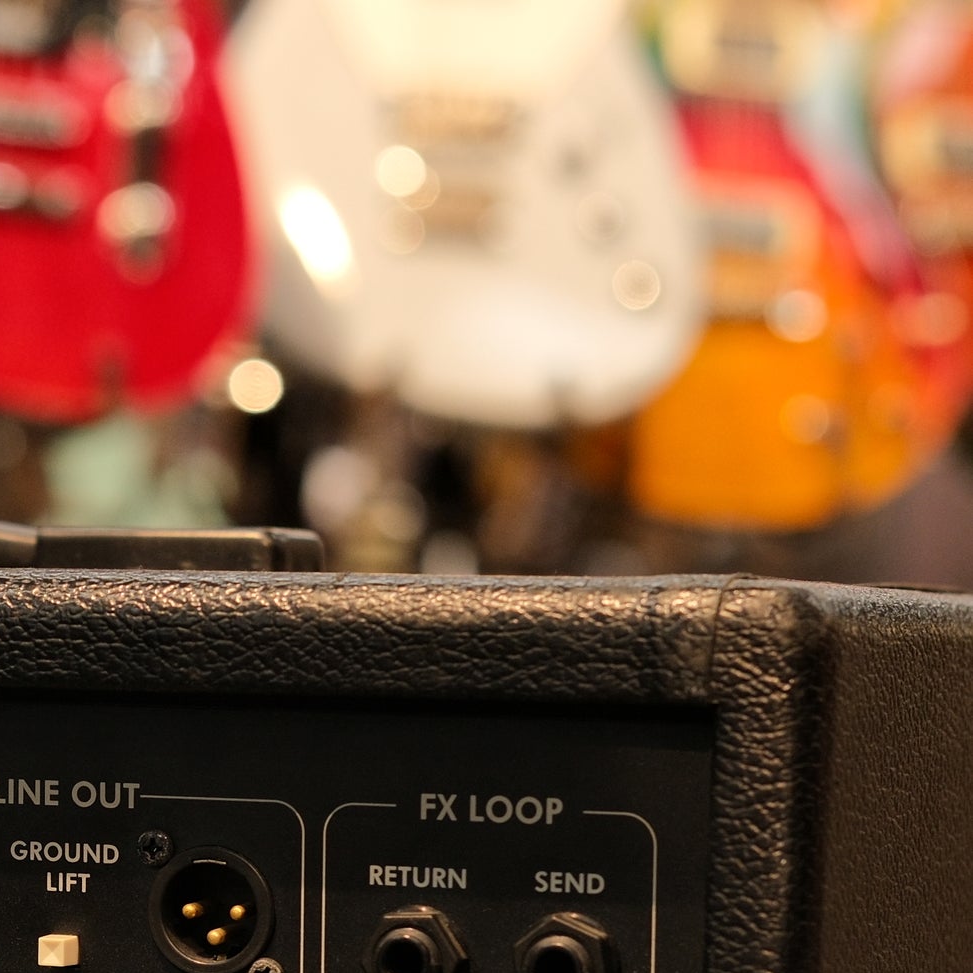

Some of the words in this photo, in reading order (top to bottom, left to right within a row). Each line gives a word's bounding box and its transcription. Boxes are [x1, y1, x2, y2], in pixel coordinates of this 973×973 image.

[70, 780, 141, 809] OUT
[420, 793, 457, 822] FX
[469, 794, 564, 825] LOOP
[10, 840, 120, 865] GROUND
[46, 872, 91, 893] LIFT
[368, 864, 468, 890] RETURN
[534, 870, 606, 895] SEND
